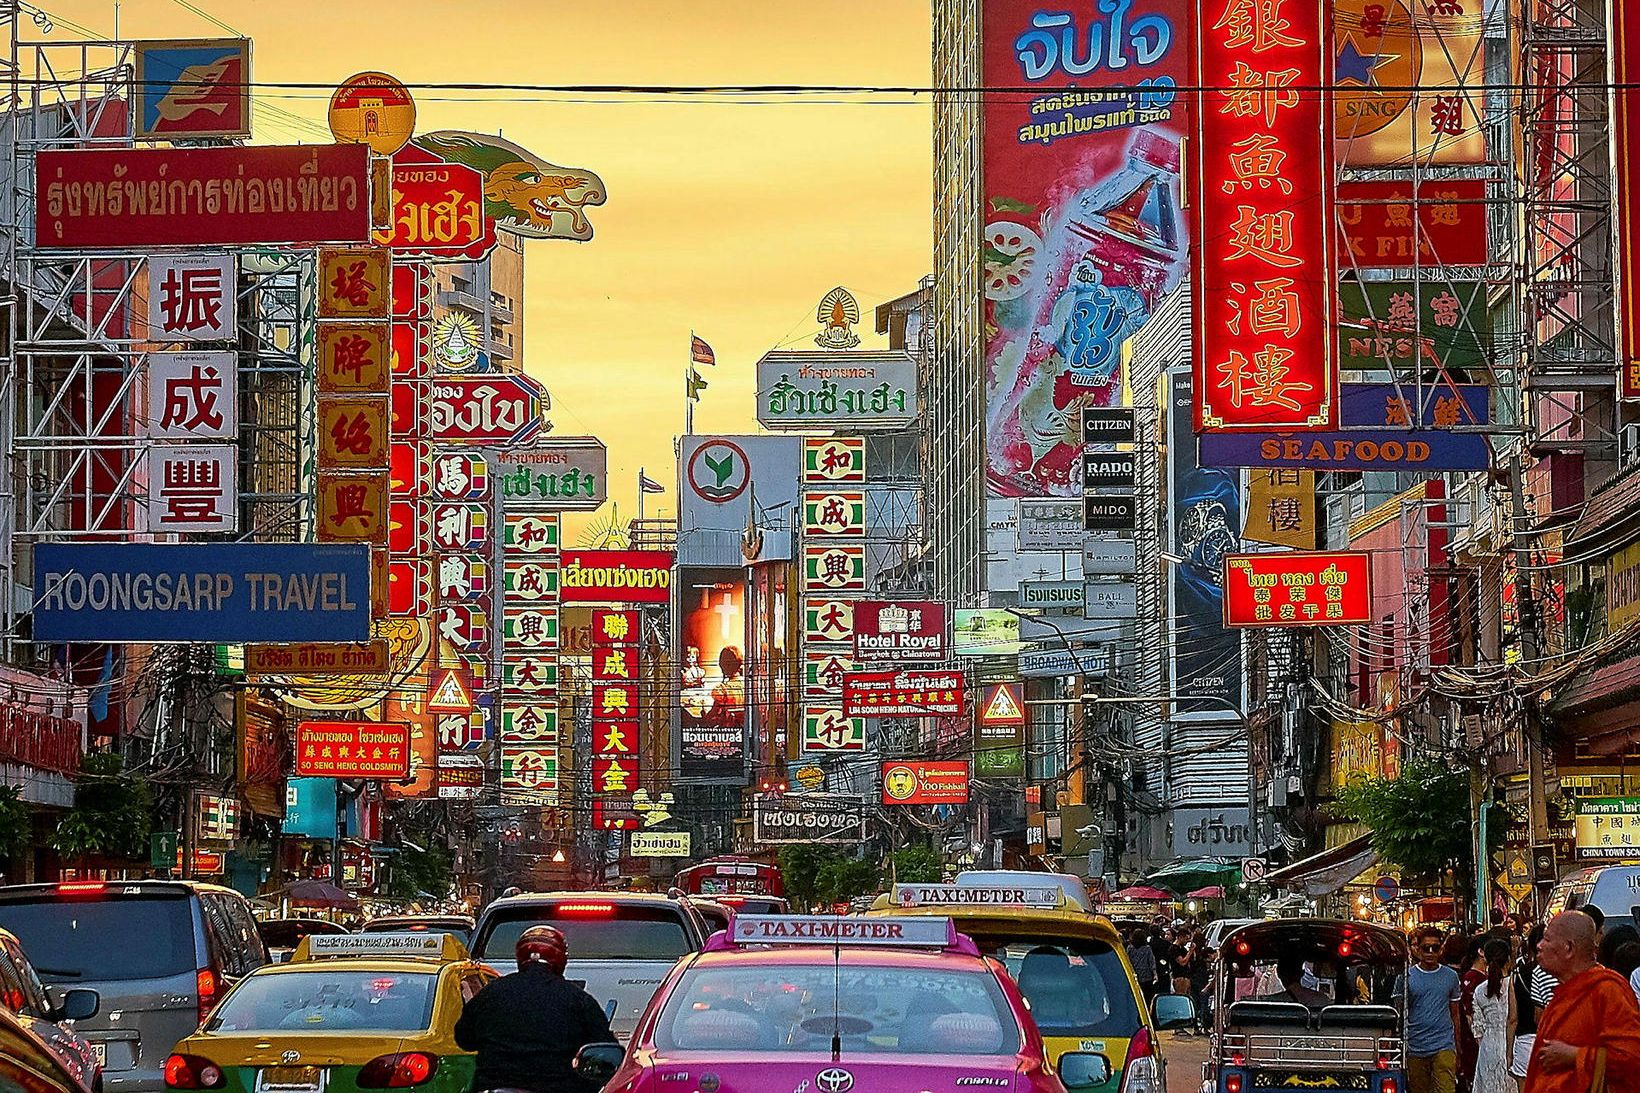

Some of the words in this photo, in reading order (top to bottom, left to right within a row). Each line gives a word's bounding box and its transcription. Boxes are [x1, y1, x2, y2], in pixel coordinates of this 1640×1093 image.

[1016, 0, 1171, 80] จับใจ
[1136, 75, 1176, 109] 10
[1086, 420, 1131, 431] CITIZEN
[1260, 440, 1431, 464] SEAFOOD
[1087, 462, 1133, 475] RADO
[1092, 505, 1127, 516] MIDO
[45, 573, 235, 611] ROONGSARP
[245, 573, 357, 611] TRAVEL
[1098, 593, 1125, 601] BALL
[857, 633, 896, 648] Hotel
[899, 633, 941, 651] Royal
[901, 650, 941, 658] Chinatown
[301, 761, 312, 769] SO
[314, 761, 334, 770] SENG
[336, 762, 358, 770] HENG
[360, 762, 404, 771] GOLDSMITH
[1582, 849, 1604, 857] CHINA
[1604, 849, 1625, 857] TOWN
[919, 888, 1025, 904] TAXI-METER
[759, 921, 904, 939] TAXI-METER
